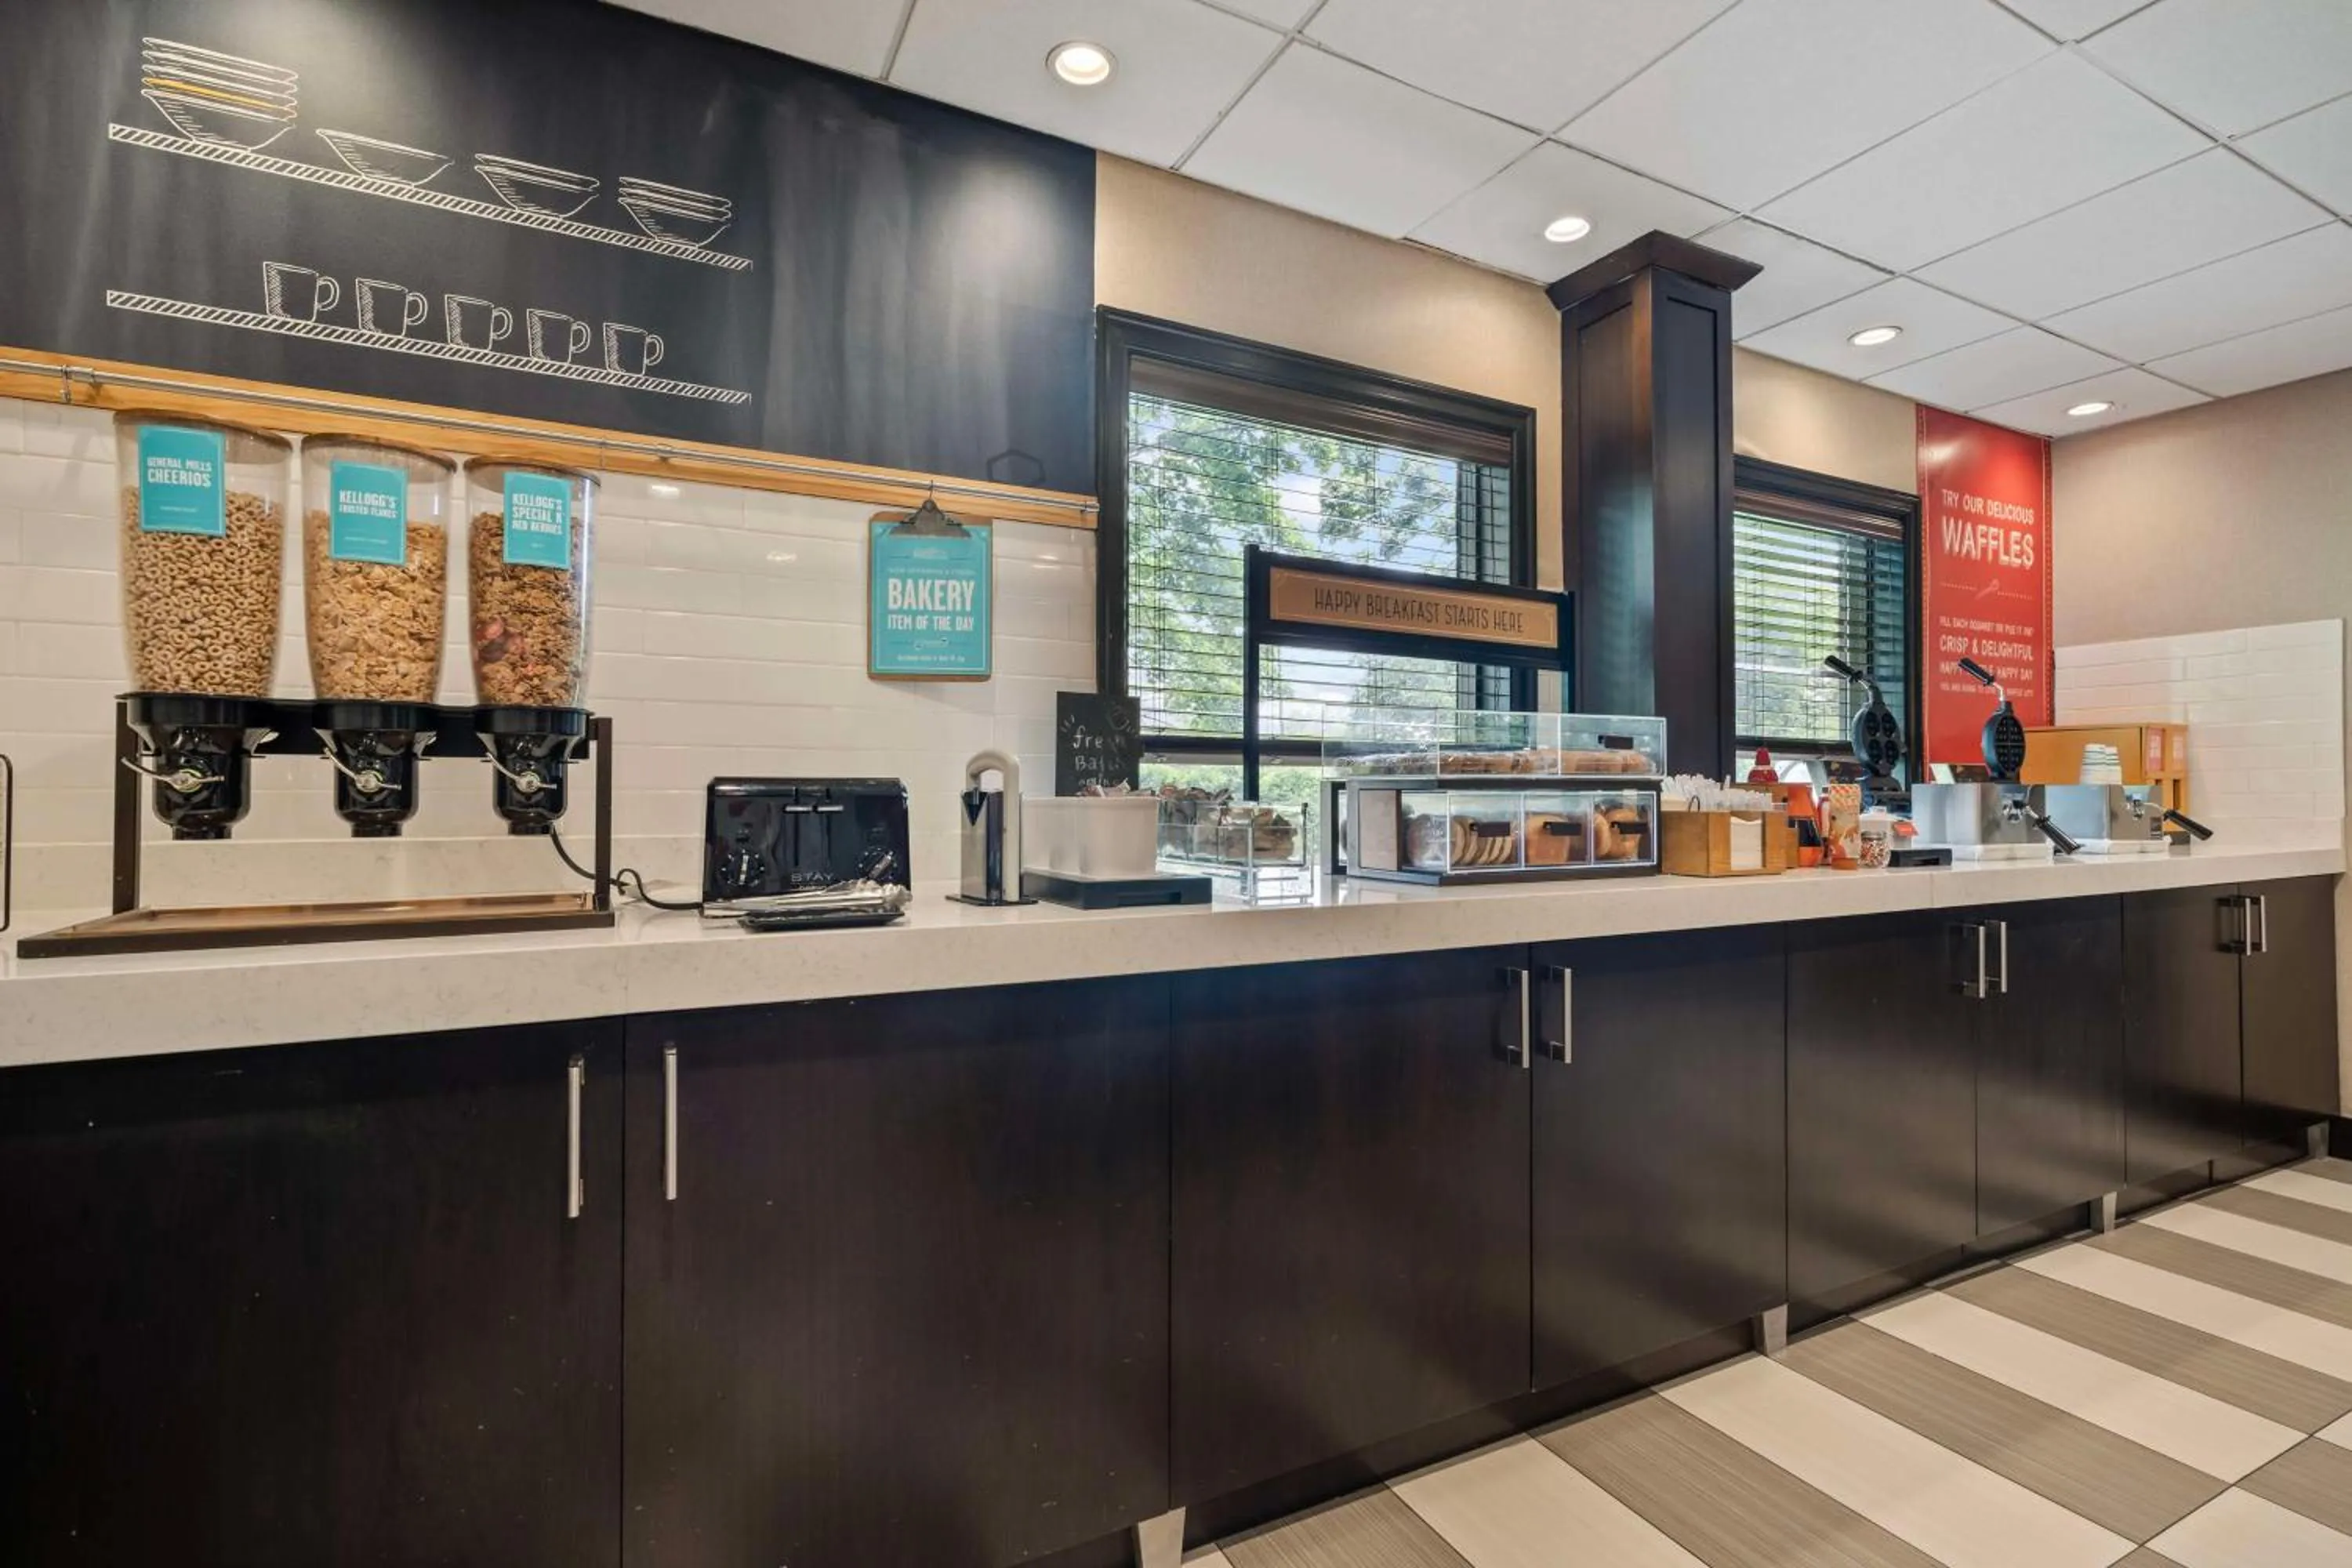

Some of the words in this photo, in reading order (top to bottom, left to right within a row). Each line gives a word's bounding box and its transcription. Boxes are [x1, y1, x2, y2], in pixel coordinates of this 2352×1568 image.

[147, 468, 212, 488] CHEERIOS
[339, 489, 398, 509] KELLOGG'S
[1942, 488, 1959, 508] TRY
[1963, 494, 1984, 515] OUR
[1987, 499, 2034, 525] DELICIOUS
[512, 506, 552, 523] SPECIAL
[1943, 515, 2034, 571] WAFFLES
[887, 578, 975, 612] BAKERY
[887, 614, 912, 631] ITEM
[916, 615, 928, 631] OF
[933, 616, 951, 631] THE
[956, 616, 974, 632] DAY
[1315, 587, 1359, 614] HAPPY
[1366, 593, 1441, 625] BREAKFAST
[1445, 604, 1489, 629] STARTS
[1494, 610, 1524, 633] HERE
[1940, 634, 1969, 653] CRISP
[1972, 638, 1979, 655] &
[1981, 639, 2033, 661] DELIGHTFUL
